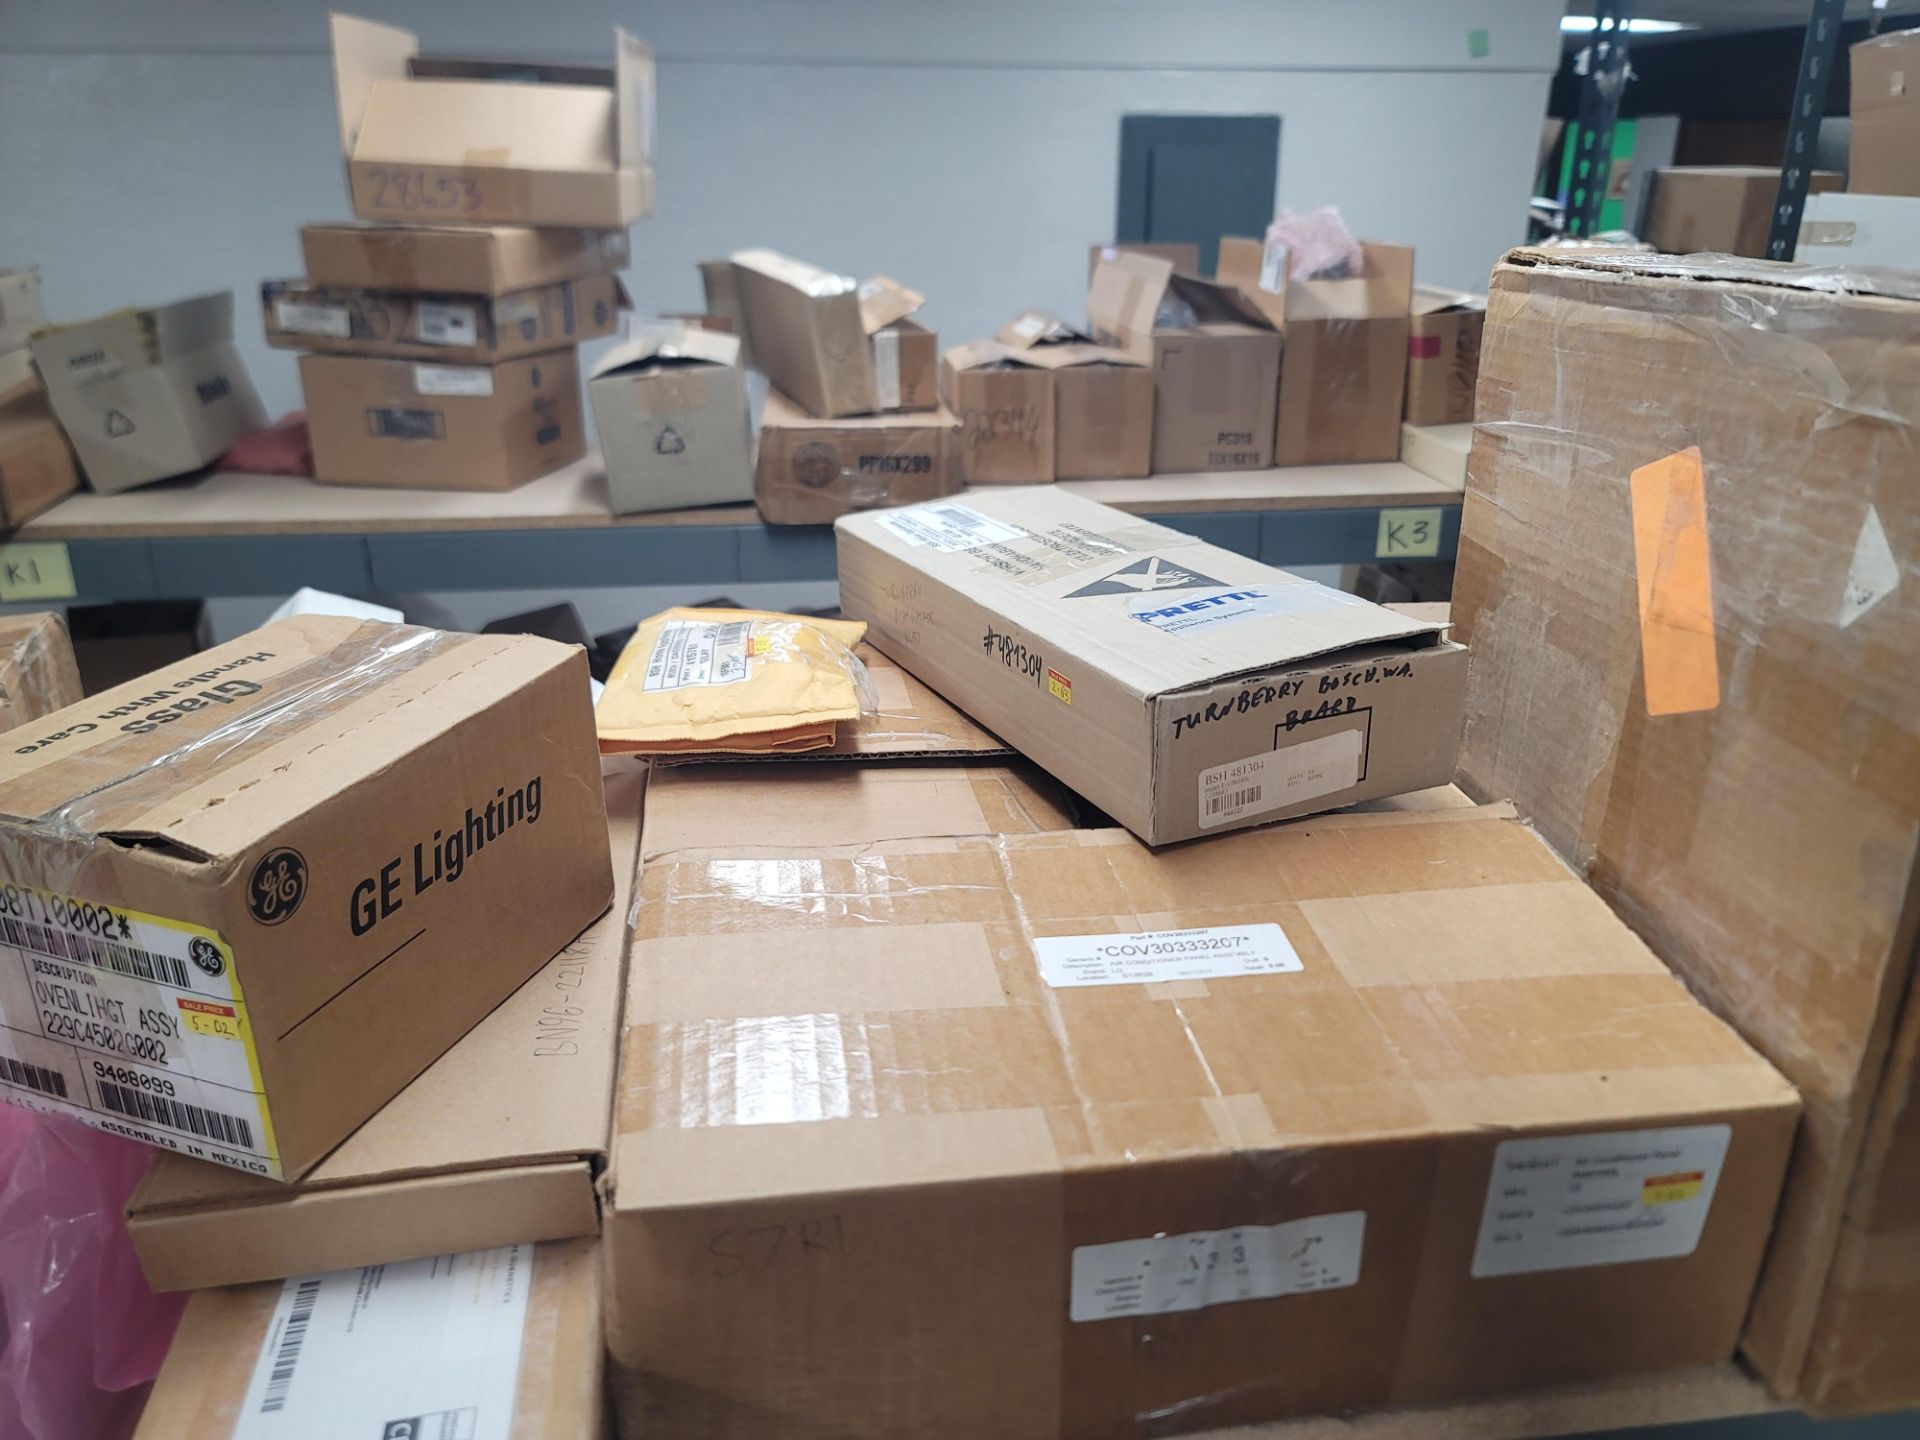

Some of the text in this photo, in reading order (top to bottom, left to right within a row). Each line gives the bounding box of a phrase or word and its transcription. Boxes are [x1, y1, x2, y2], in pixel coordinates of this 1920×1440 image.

[173, 651, 277, 689] Handle
[983, 625, 1043, 688] #481304
[120, 679, 263, 734] Glass
[14, 723, 99, 754] Care
[1205, 772, 1227, 786] BSH
[351, 775, 542, 937] GE Lighting
[32, 958, 97, 987] DESCRIPTION
[35, 980, 180, 1039] OVENLIHGT ASSY
[43, 1010, 169, 1065] 229C4502G002
[93, 1060, 175, 1098] 9408099
[101, 1120, 268, 1174] ASSEMBLED IN MEXICO
